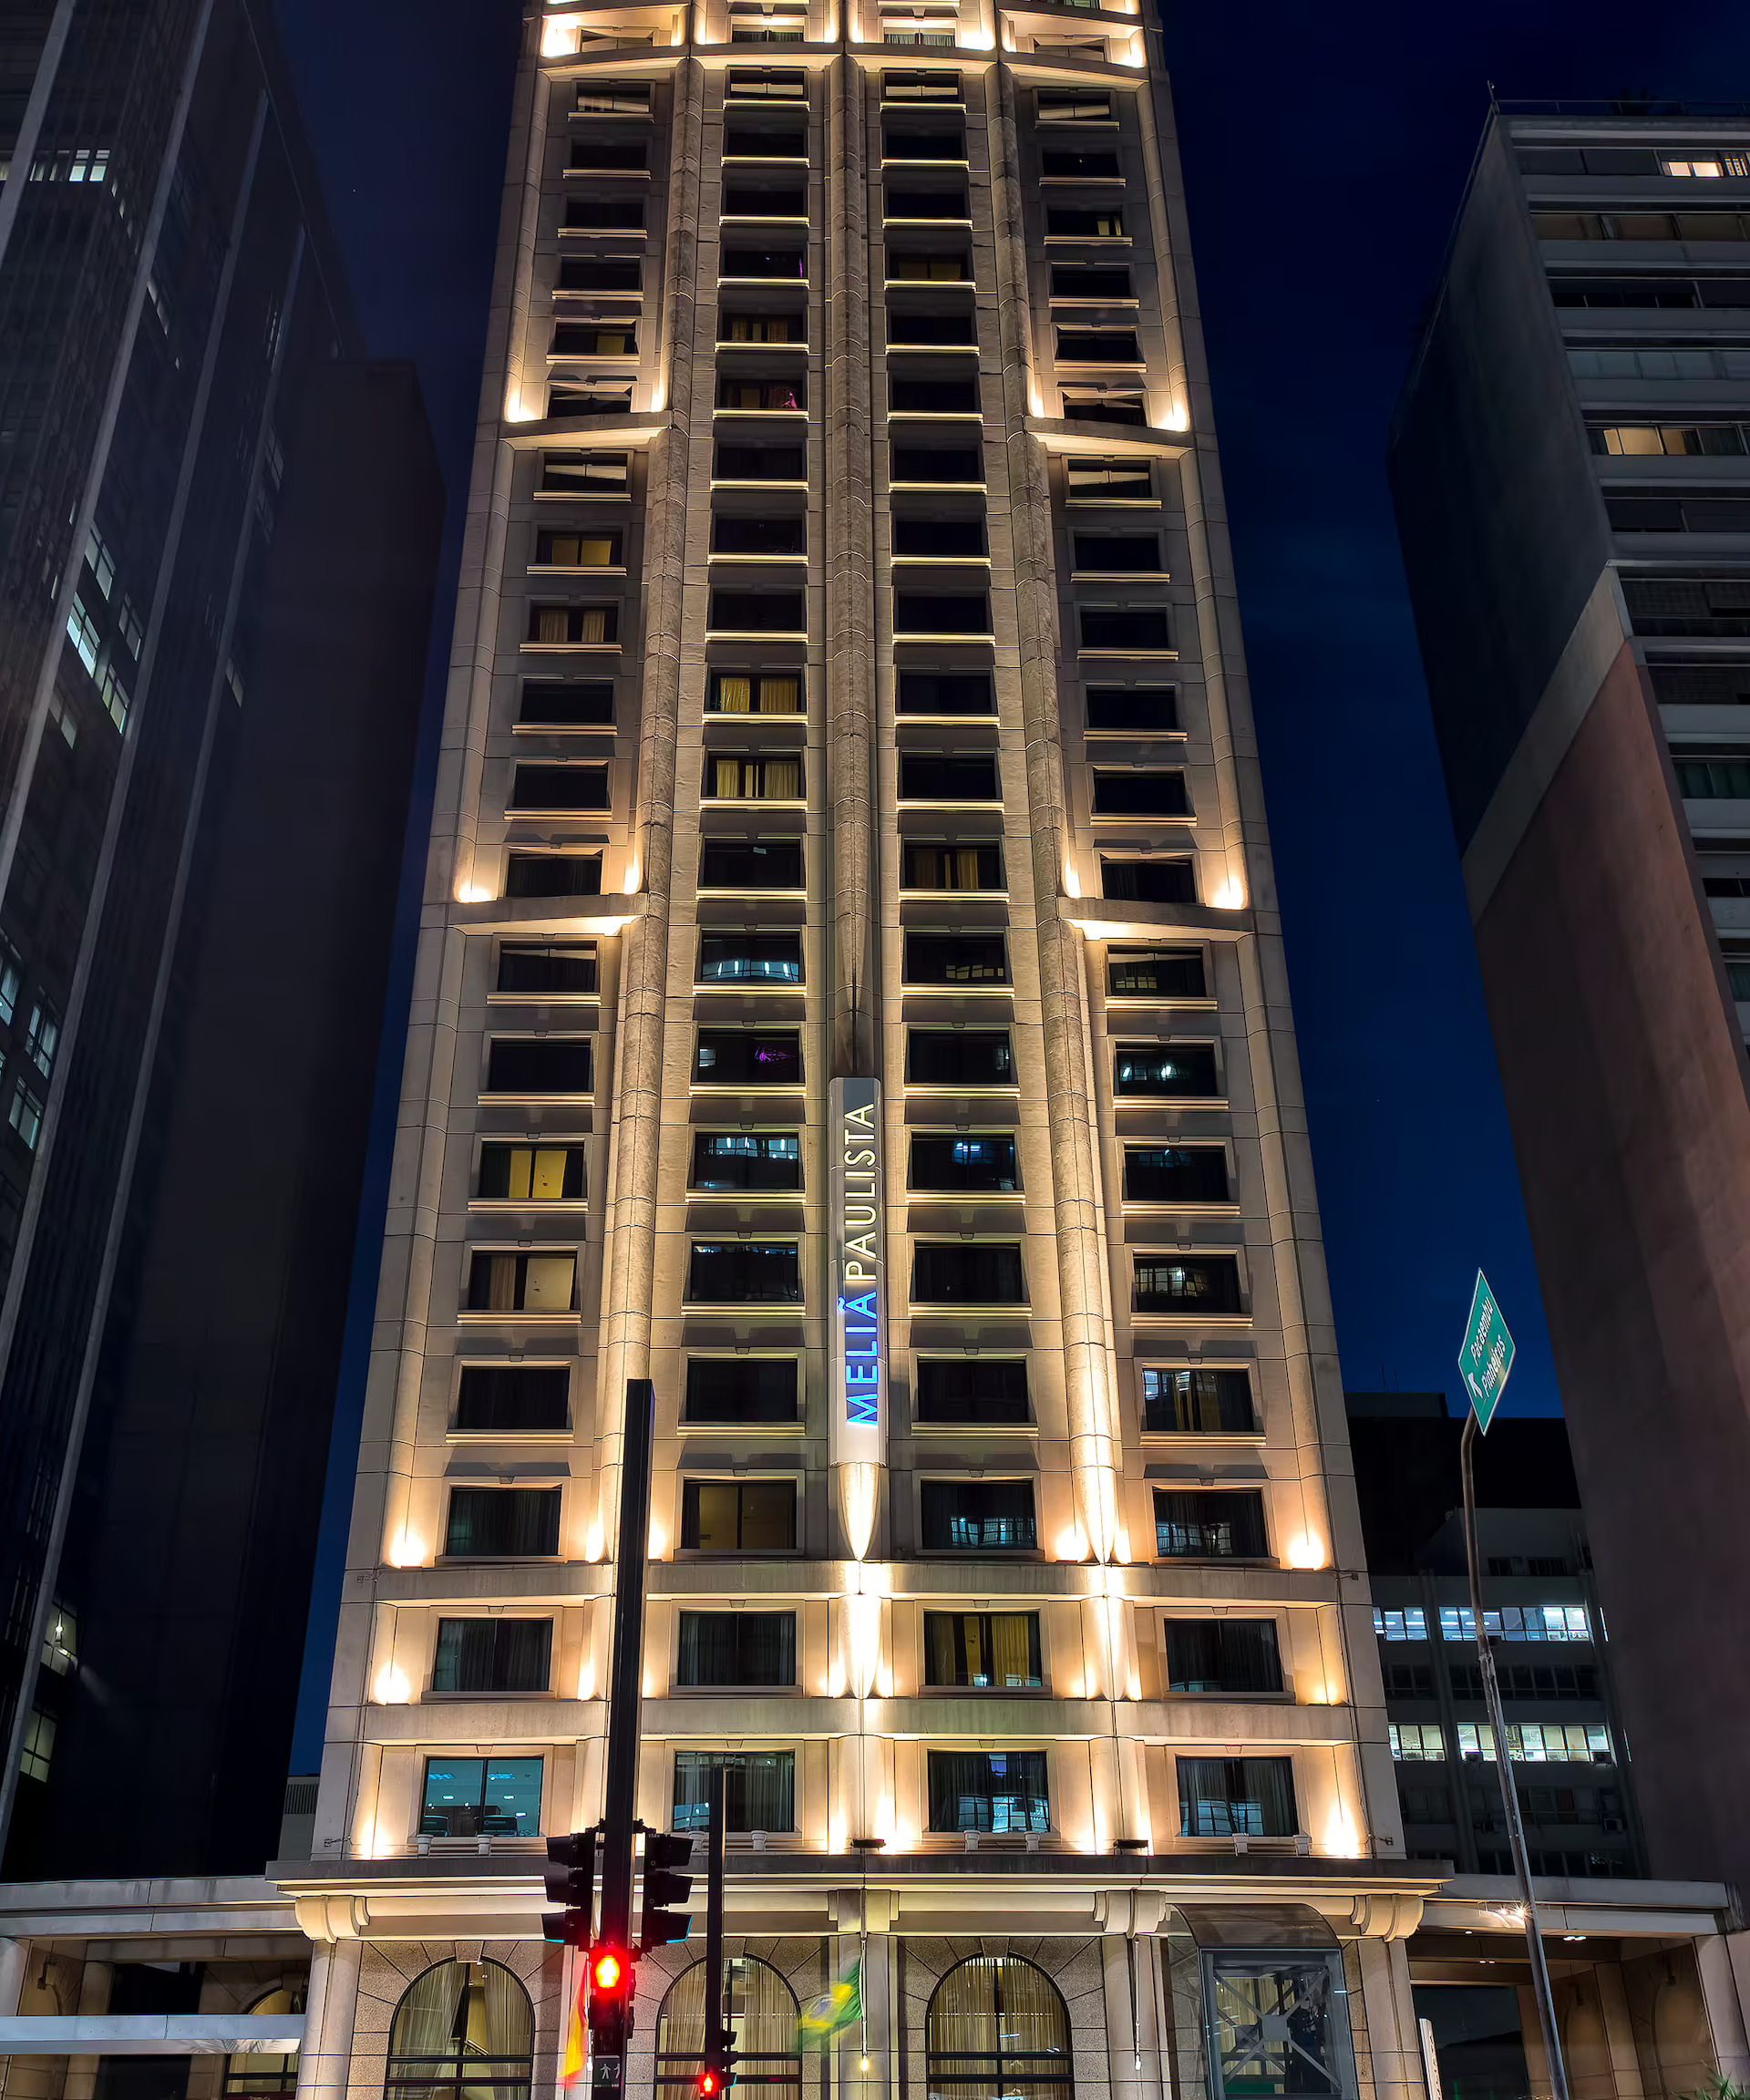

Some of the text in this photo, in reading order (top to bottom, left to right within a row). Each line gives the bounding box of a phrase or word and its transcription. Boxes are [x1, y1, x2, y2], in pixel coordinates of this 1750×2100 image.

[843, 1102, 878, 1282] PAULISTA
[1470, 1296, 1493, 1367] Pacaembu
[1481, 1334, 1506, 1397] Pinheiros
